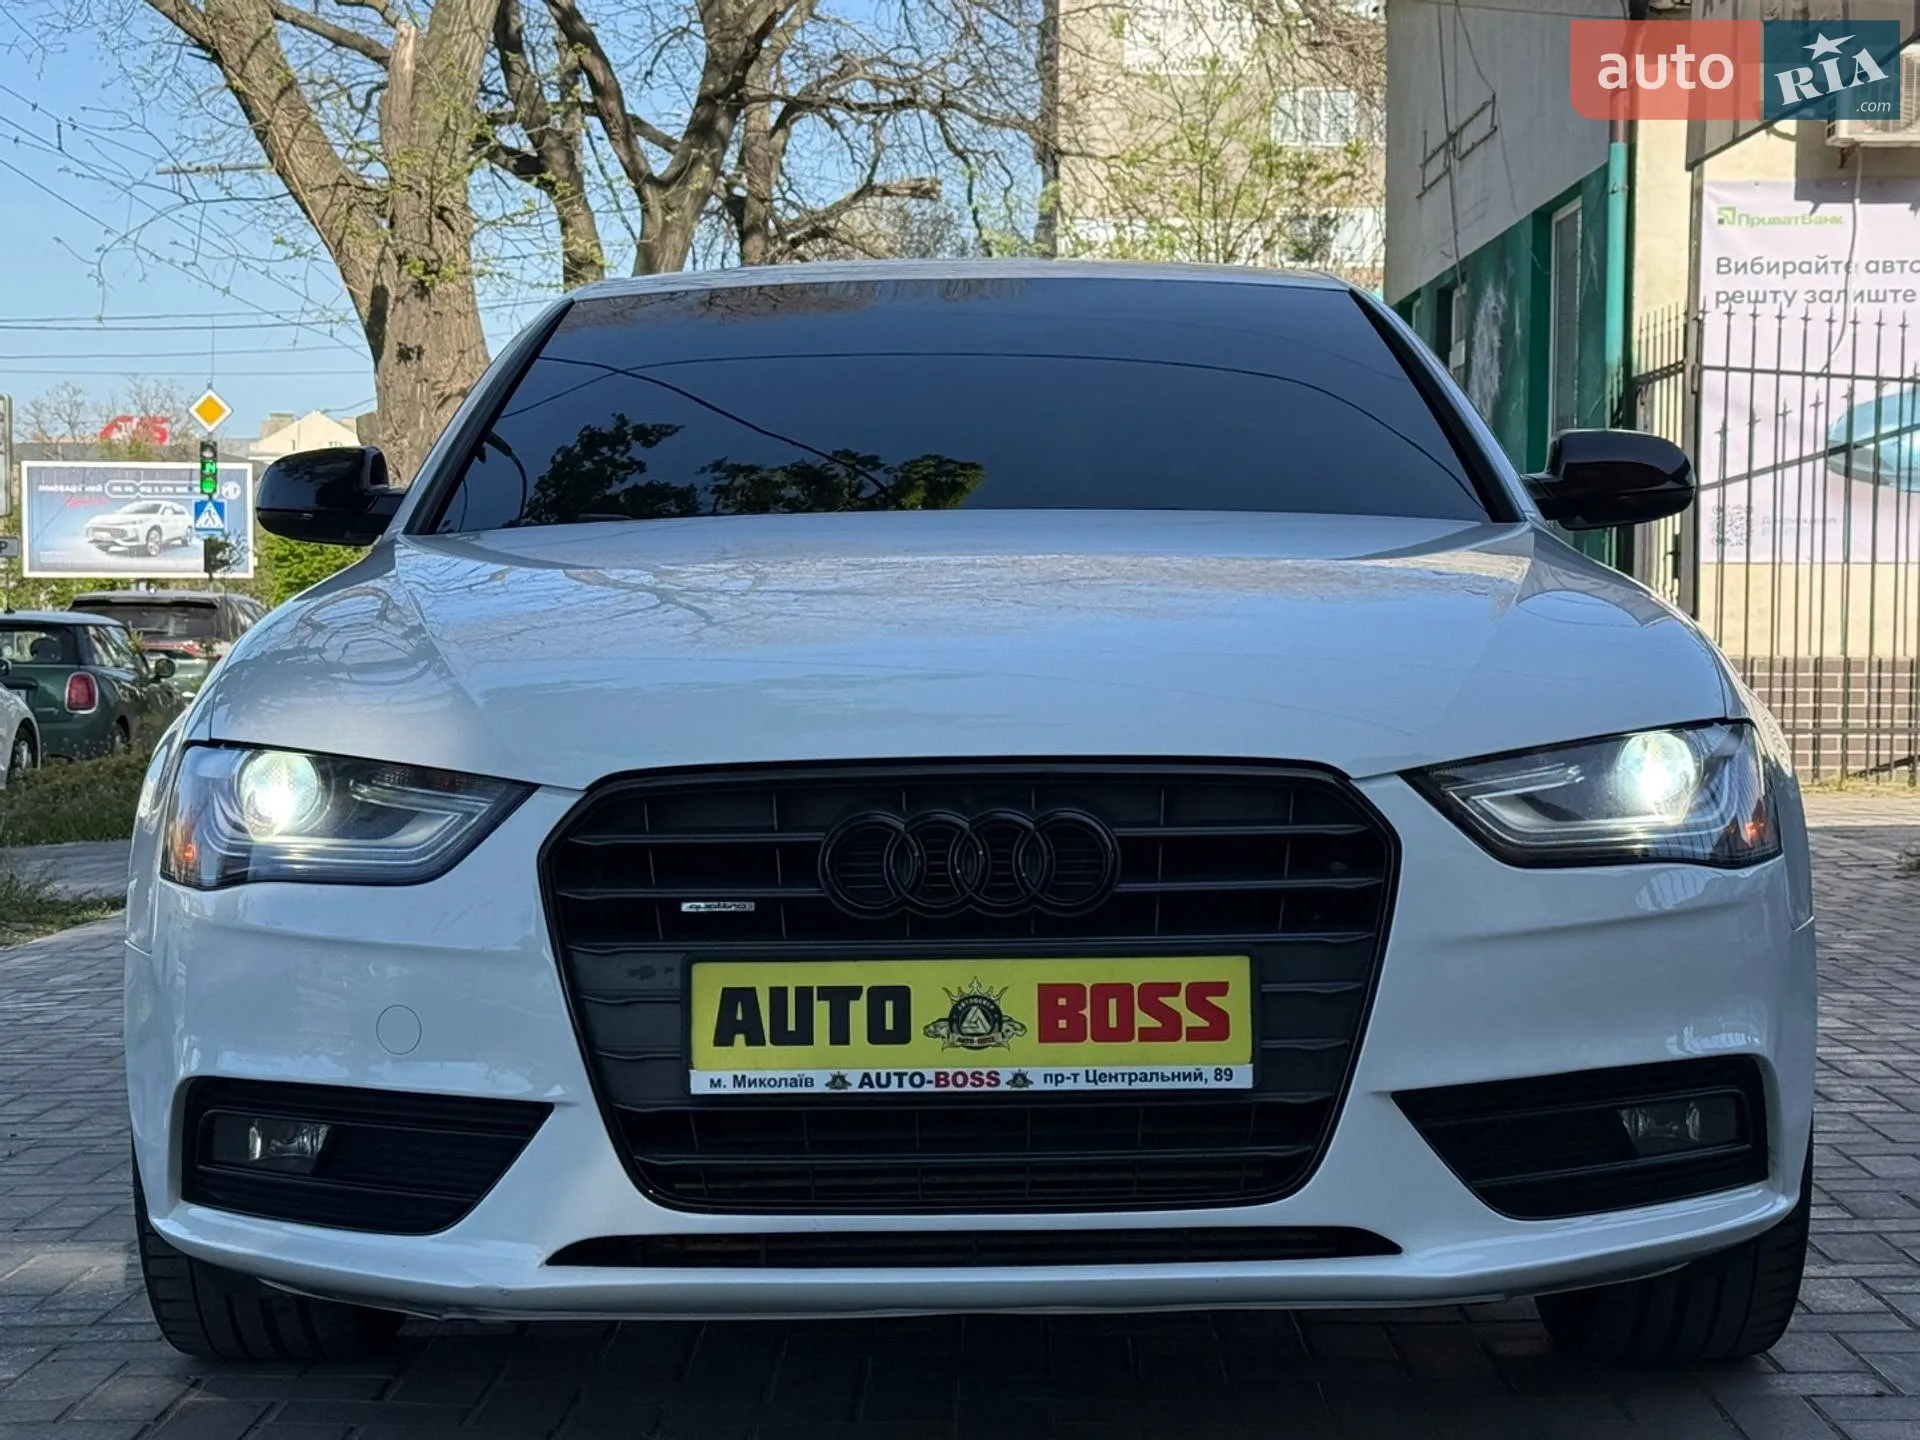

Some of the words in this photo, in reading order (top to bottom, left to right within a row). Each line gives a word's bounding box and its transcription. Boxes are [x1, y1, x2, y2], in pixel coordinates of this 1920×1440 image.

[1737, 213, 1844, 228] ПриватБанк
[1714, 288, 1798, 309] решту
[1803, 287, 1917, 305] залиште
[712, 984, 913, 1047] AUTO
[1037, 981, 1231, 1044] BOSS
[709, 1077, 727, 1089] м.
[732, 1073, 815, 1089] Миколаїв
[857, 1070, 1001, 1089] AUTO-BOSS
[1043, 1069, 1081, 1088] пр-т
[1085, 1067, 1208, 1086] Центральний,
[1214, 1067, 1234, 1083] 89
